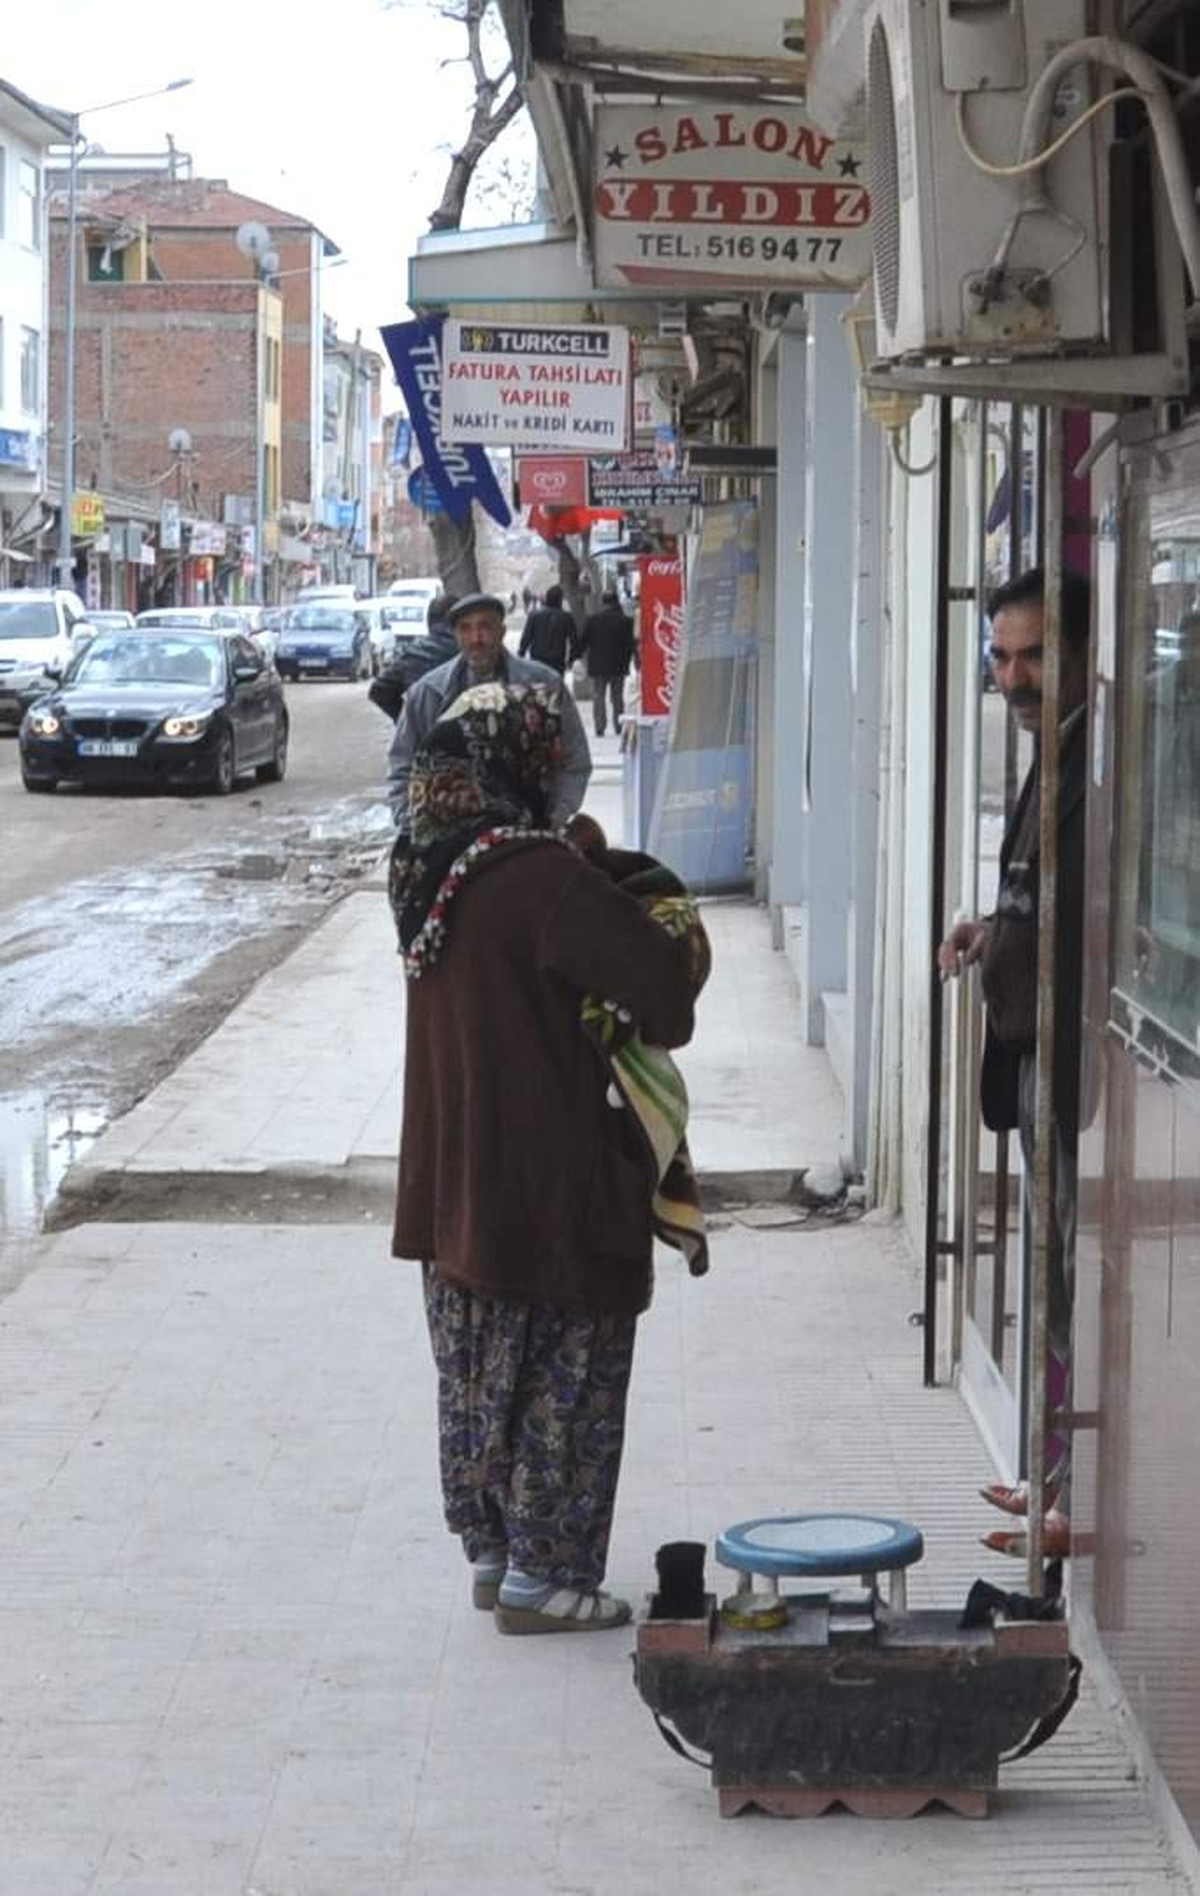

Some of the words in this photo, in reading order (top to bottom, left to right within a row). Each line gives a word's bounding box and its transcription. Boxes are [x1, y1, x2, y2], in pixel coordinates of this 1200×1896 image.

[634, 113, 834, 170] SALON
[602, 183, 865, 223] YILDIZ
[498, 332, 606, 353] TURKCELL
[449, 362, 520, 381] FATURA
[529, 363, 622, 385] TAHSİLATI
[500, 389, 570, 408] YAPILIR
[504, 419, 518, 429] ve
[573, 420, 615, 436] KARTI
